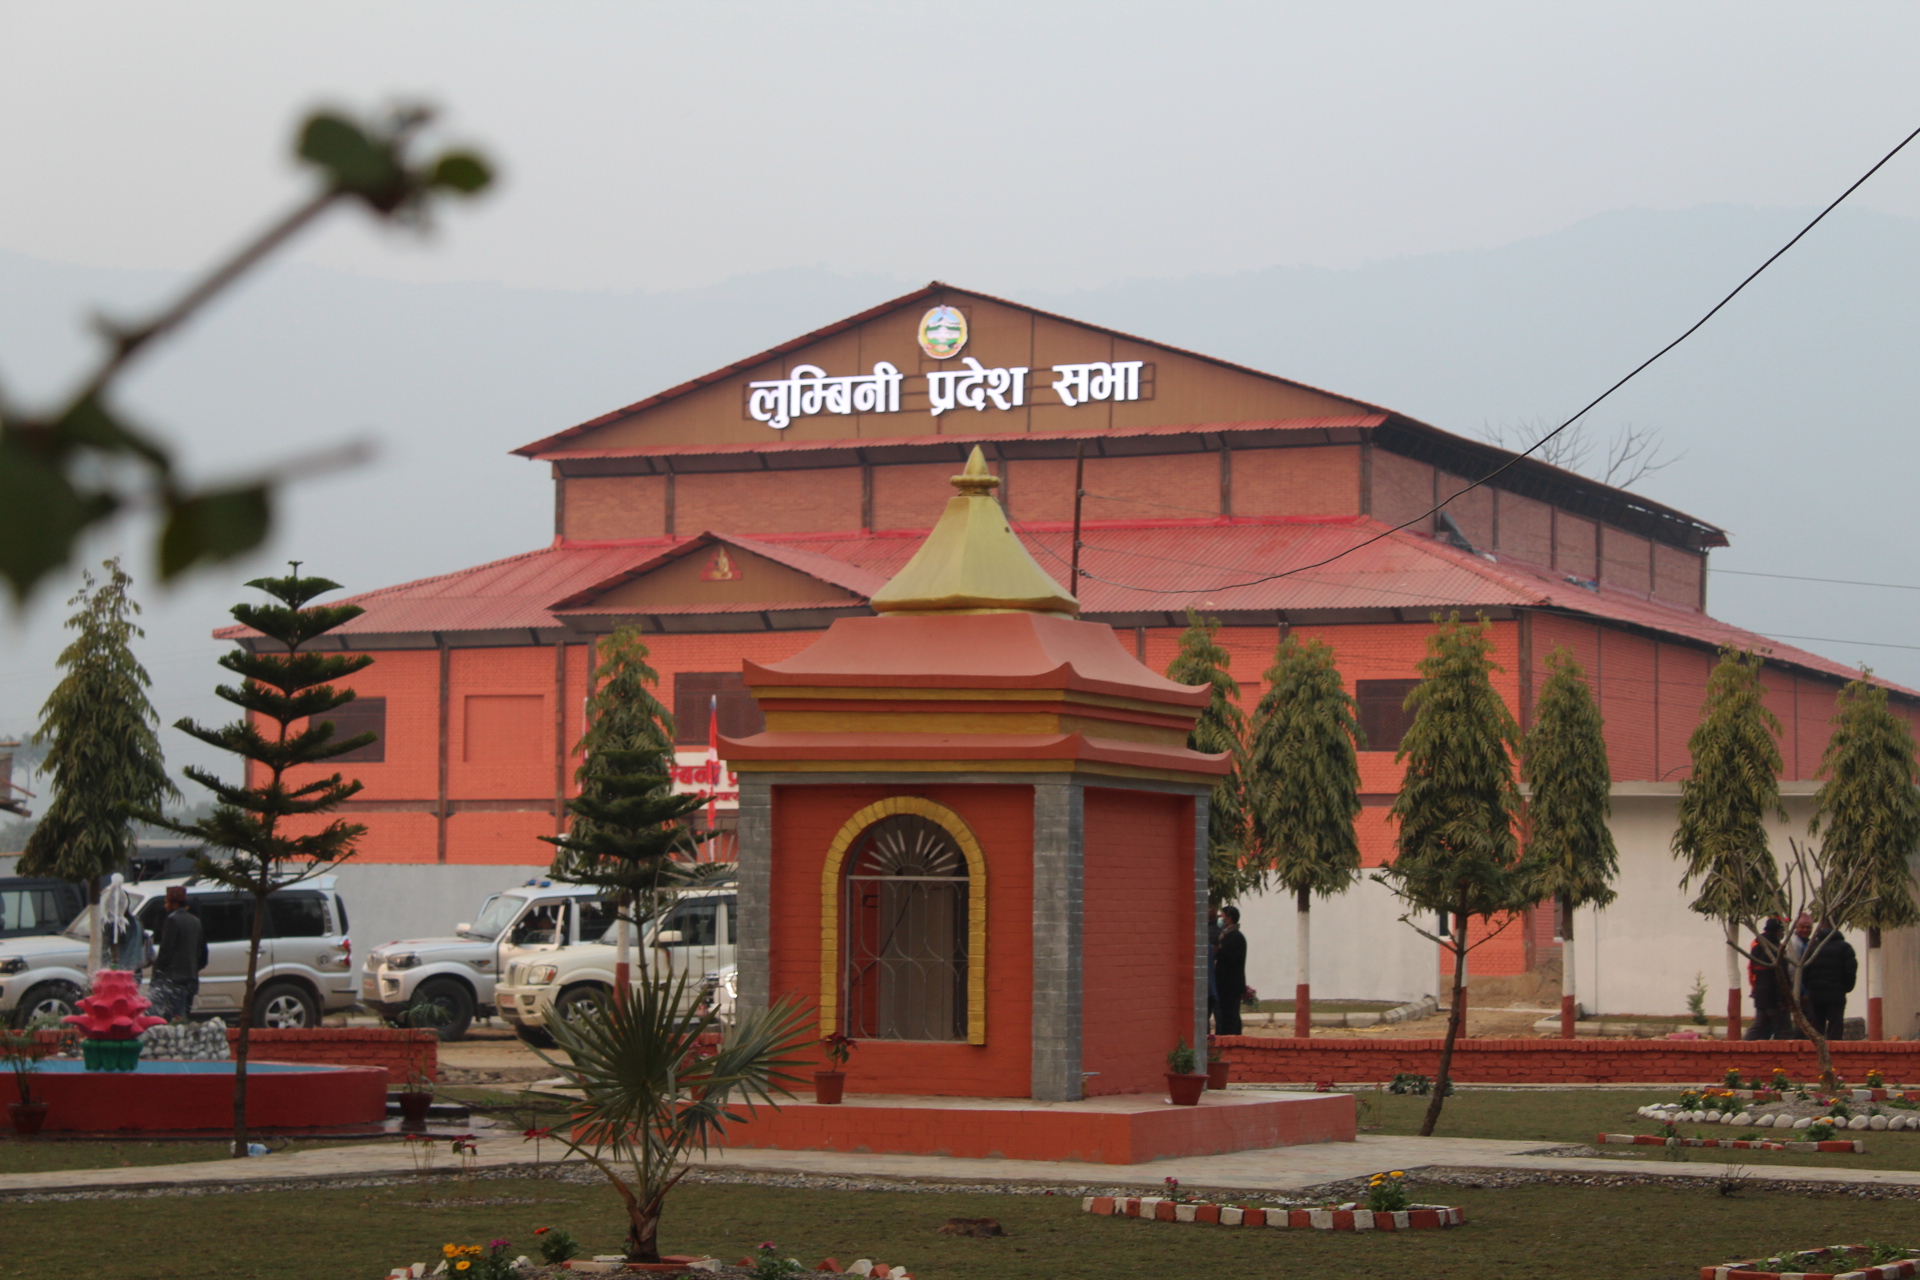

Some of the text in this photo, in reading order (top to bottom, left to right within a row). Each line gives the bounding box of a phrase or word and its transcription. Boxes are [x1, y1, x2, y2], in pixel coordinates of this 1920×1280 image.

[749, 356, 1143, 429] लुम्बिनी प्रदेश सभा
